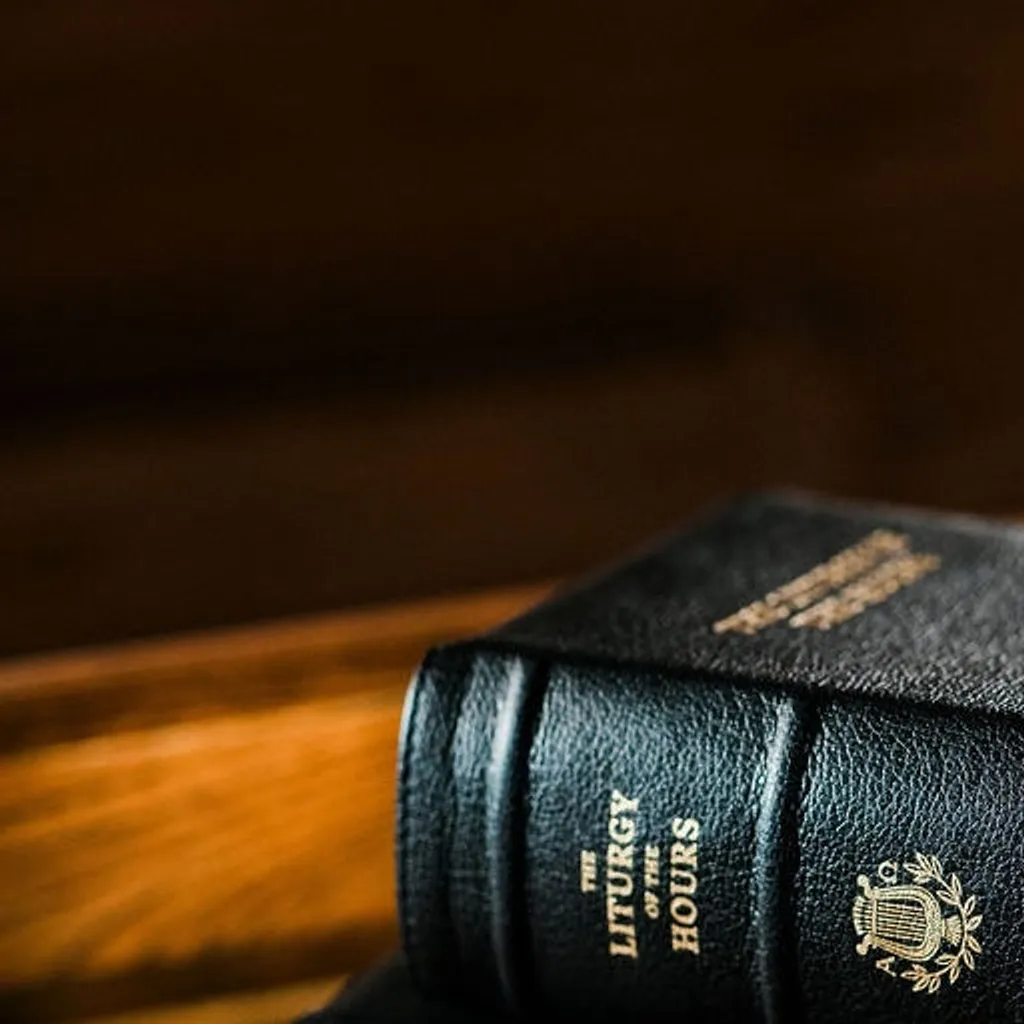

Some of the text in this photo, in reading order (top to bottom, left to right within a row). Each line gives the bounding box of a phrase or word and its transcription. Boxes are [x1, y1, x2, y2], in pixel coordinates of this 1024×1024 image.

[580, 849, 597, 893] THE
[606, 788, 640, 959] LITURGY
[644, 843, 660, 919] OF THE
[669, 817, 700, 954] HOURS
